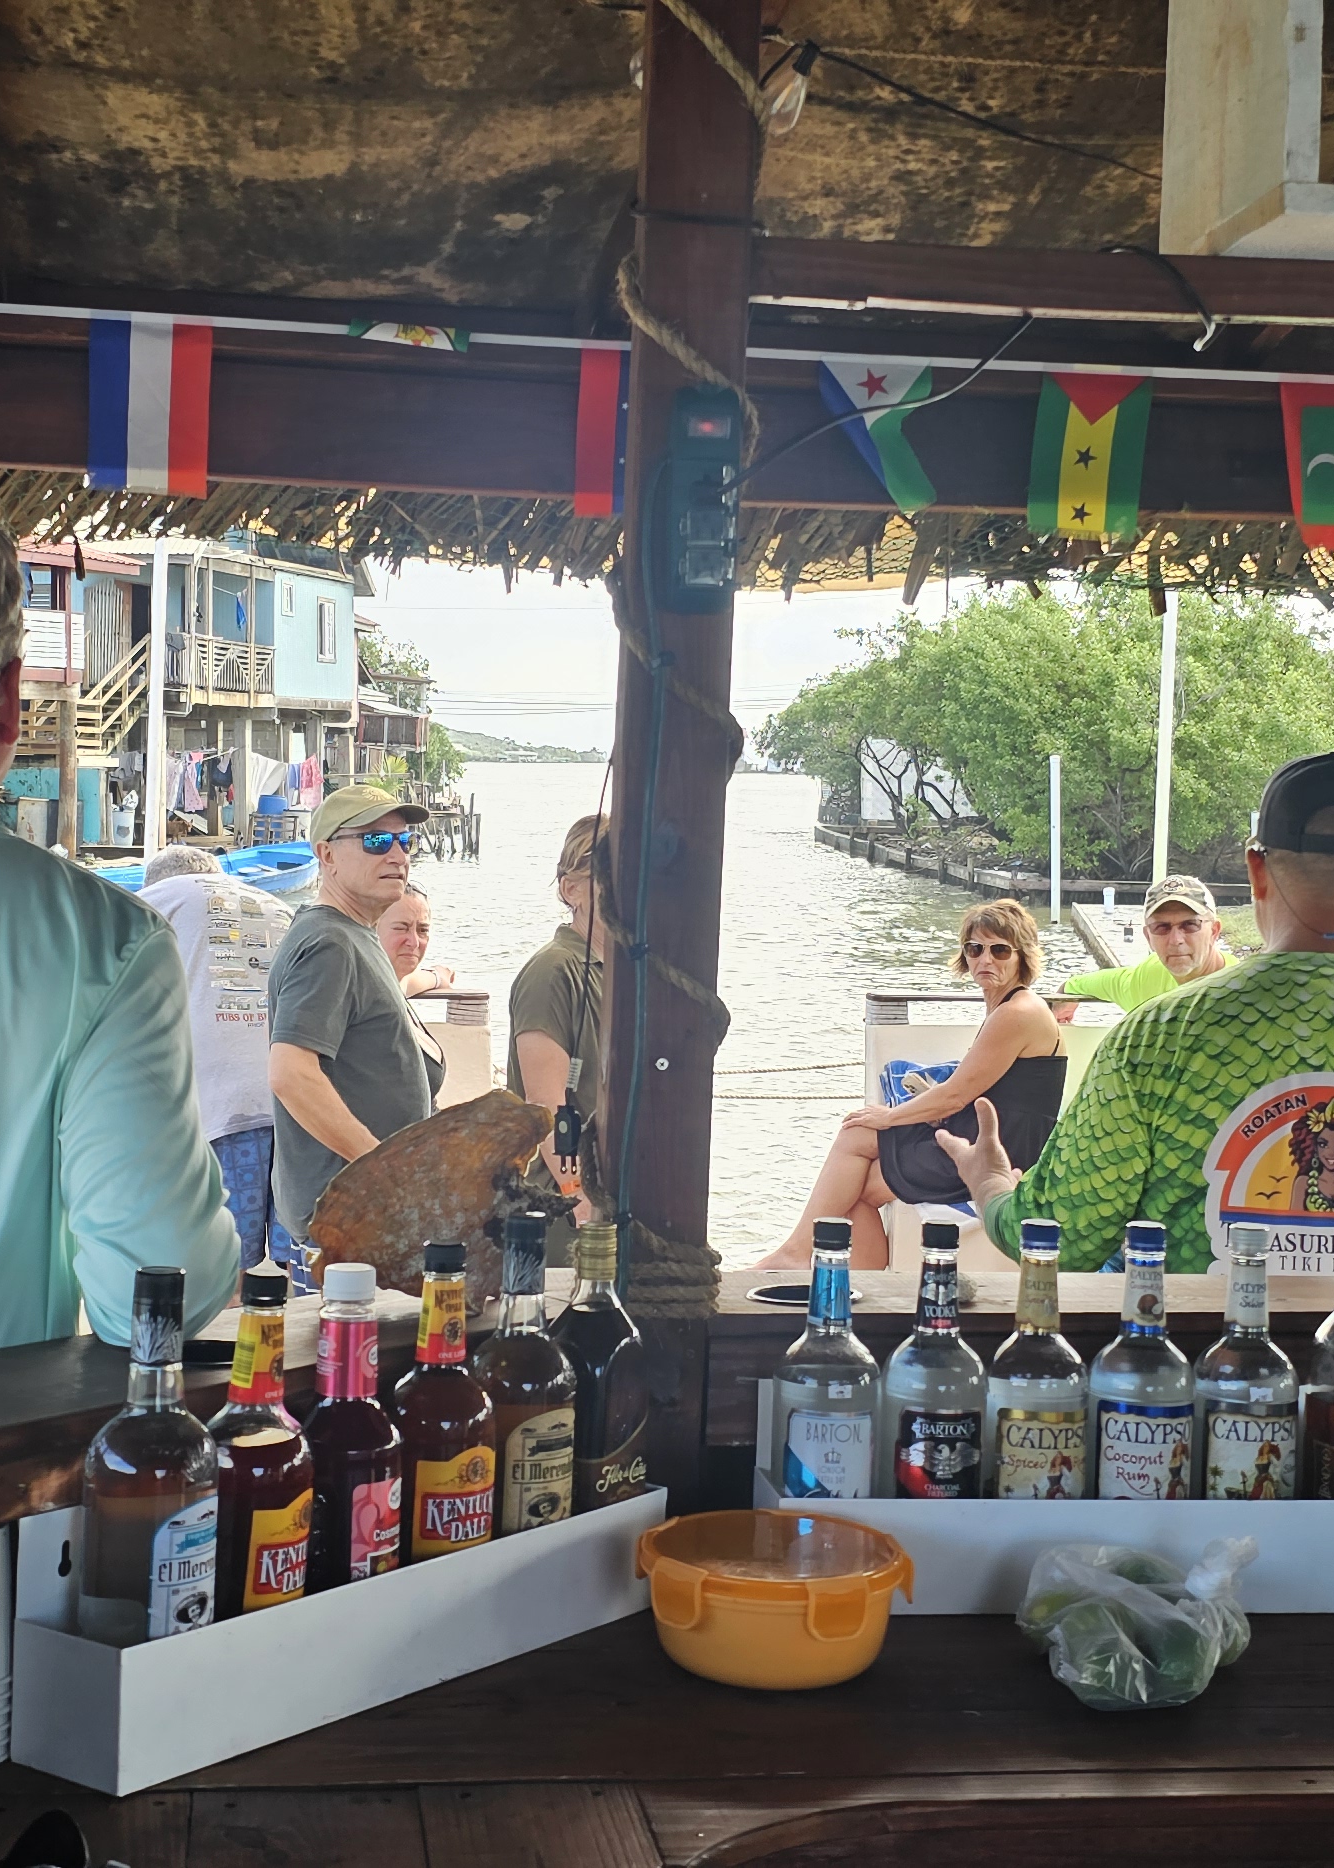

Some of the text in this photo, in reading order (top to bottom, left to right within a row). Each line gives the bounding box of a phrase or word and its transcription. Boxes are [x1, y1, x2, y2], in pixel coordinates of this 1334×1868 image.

[215, 1013, 240, 1022] PUBS
[1240, 1093, 1308, 1139] ROATAN
[1279, 1256, 1321, 1272] TIKI
[924, 1305, 956, 1317] VODKA
[921, 1424, 967, 1435] BARTON
[1105, 1417, 1190, 1444] CALYPSO
[1007, 1452, 1049, 1476] Spiced
[1104, 1445, 1164, 1470] Coconut
[512, 1463, 525, 1480] El
[596, 1463, 623, 1492] Flor
[1116, 1466, 1153, 1494] Rum
[450, 1515, 489, 1541] DALE
[158, 1562, 173, 1582] El
